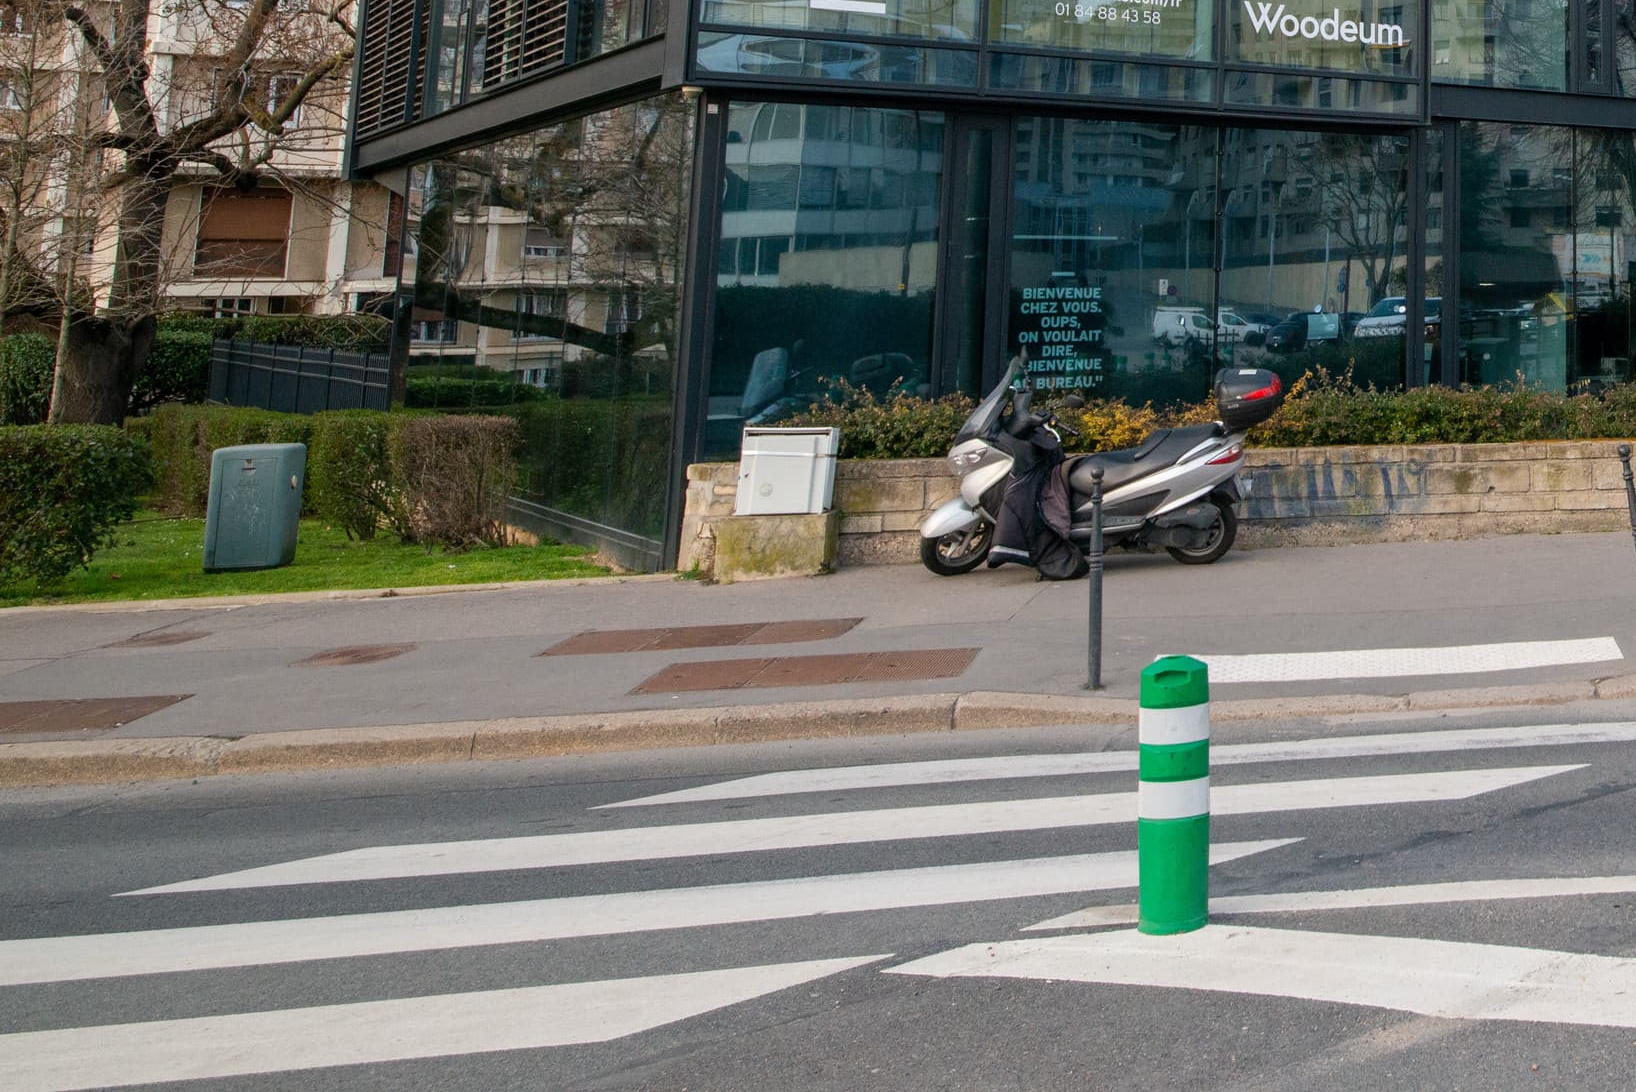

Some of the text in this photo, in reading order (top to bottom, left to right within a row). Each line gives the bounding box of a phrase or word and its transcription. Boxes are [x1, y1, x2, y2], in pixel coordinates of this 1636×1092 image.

[1055, 2, 1161, 25] 01 84 88 43 58
[1243, 0, 1404, 47] Woodeum
[1022, 287, 1102, 300] BIENVENUE
[1020, 301, 1102, 314] CHEZ VOUS.
[1040, 316, 1081, 329] OUPS,
[1018, 330, 1102, 344] ON VOULAIT
[1042, 345, 1078, 358] DIRE,
